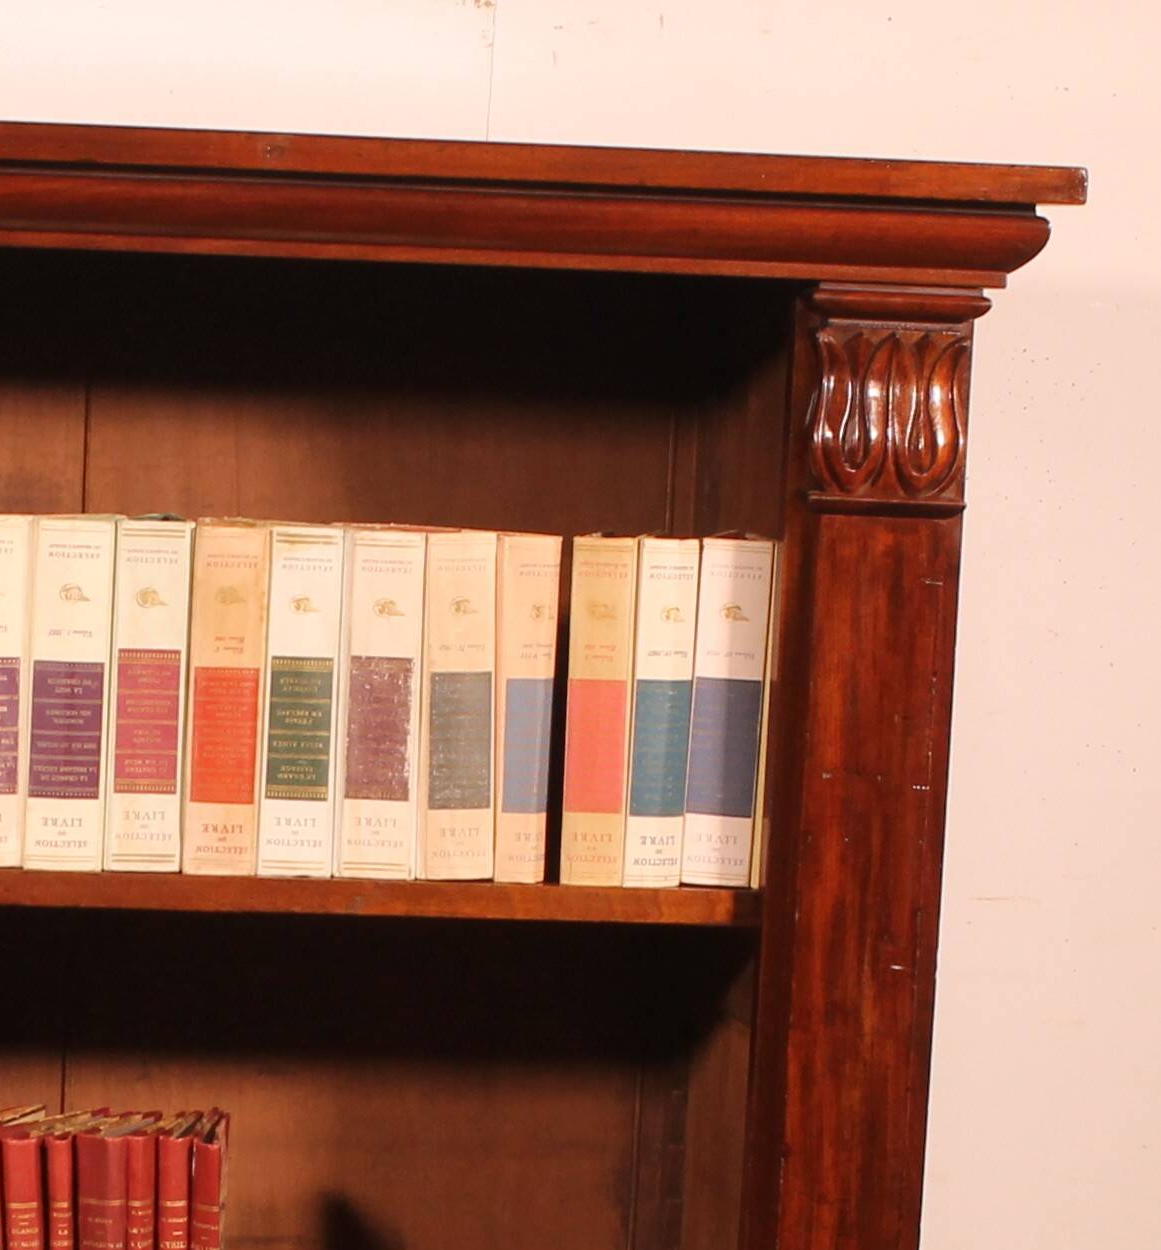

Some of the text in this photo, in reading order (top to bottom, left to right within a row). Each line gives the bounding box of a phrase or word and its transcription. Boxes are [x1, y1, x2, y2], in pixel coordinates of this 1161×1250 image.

[121, 810, 165, 821] LIVRE
[40, 816, 83, 827] LIVRE
[274, 817, 316, 828] LIVRE
[354, 817, 396, 828] LIVRE
[201, 824, 243, 835] LIVRE
[572, 832, 613, 842] LIVRE
[639, 835, 675, 845] LIVRE
[695, 834, 737, 845] LIVRE
